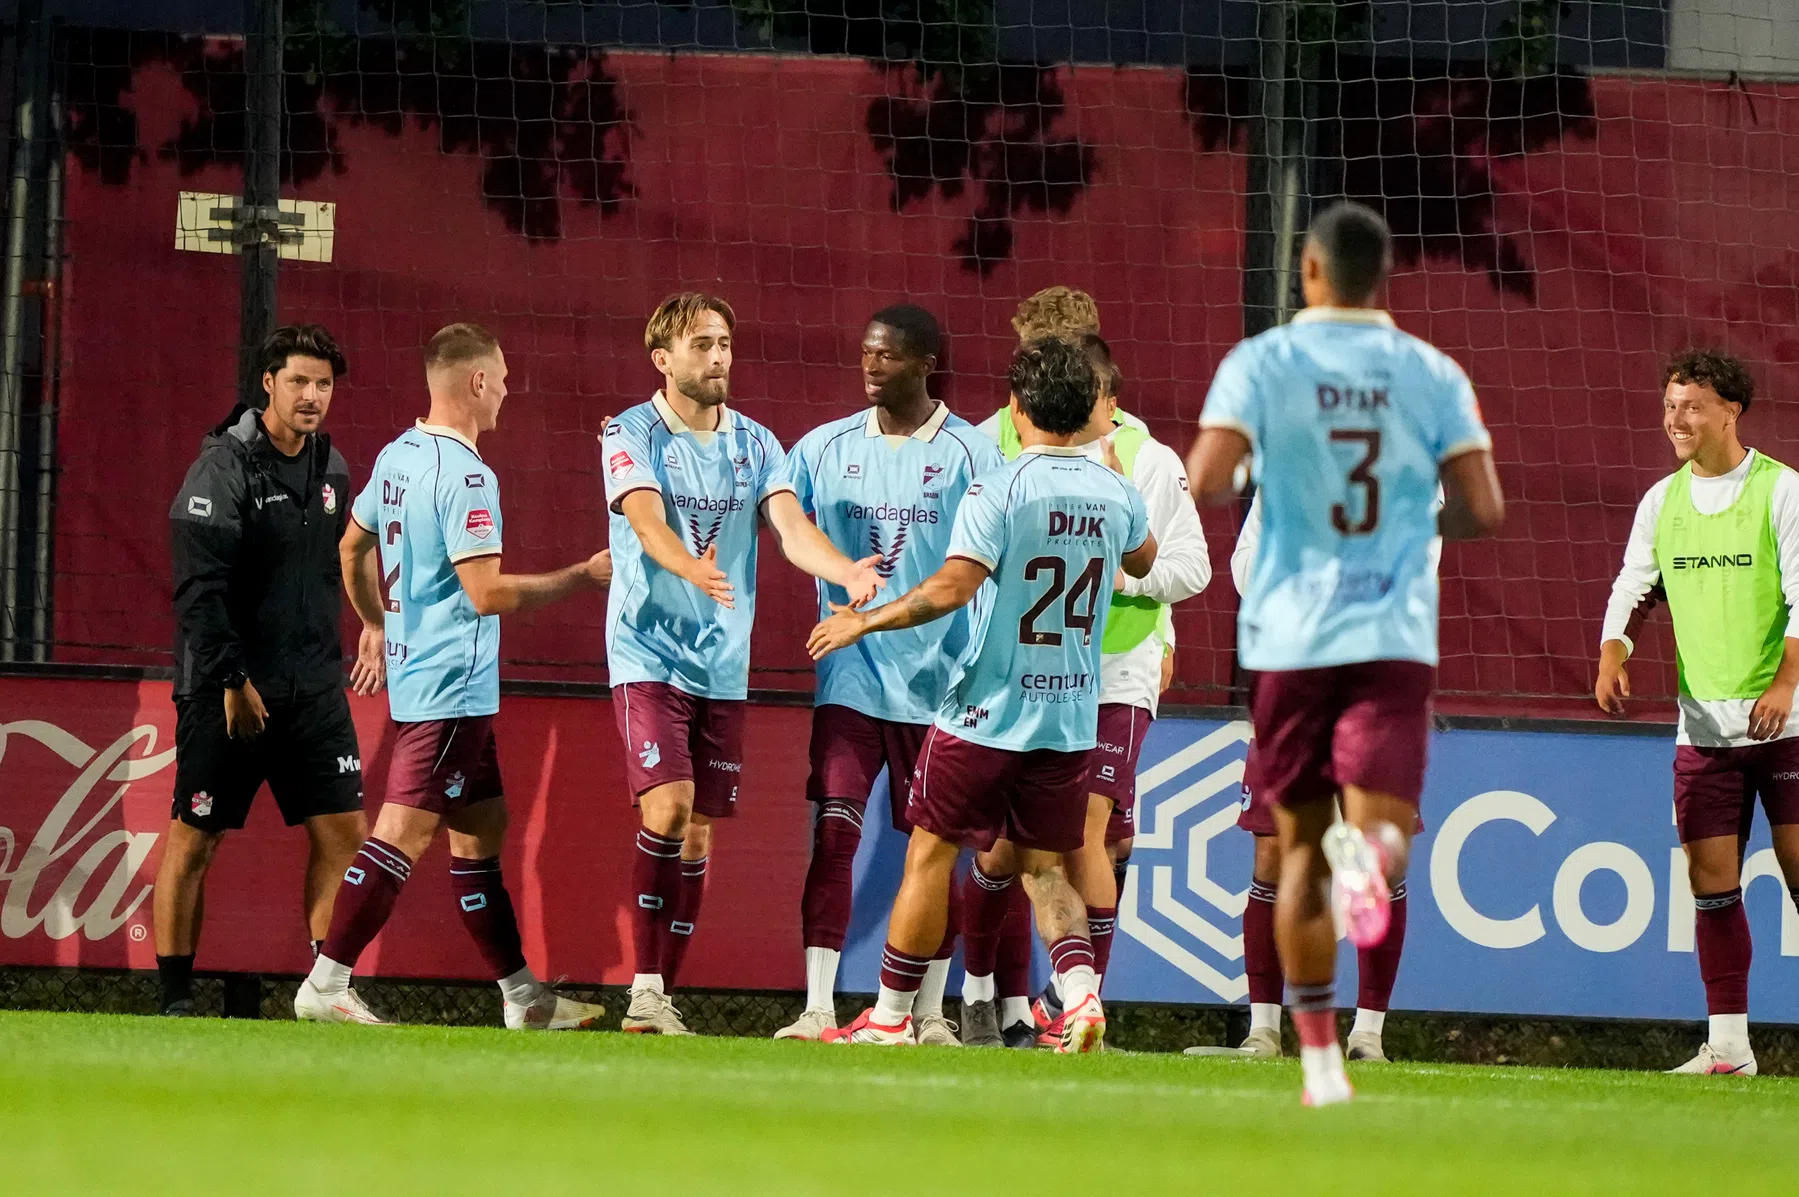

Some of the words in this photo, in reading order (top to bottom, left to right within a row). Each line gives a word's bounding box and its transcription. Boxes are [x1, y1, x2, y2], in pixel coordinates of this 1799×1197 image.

[1330, 429, 1381, 536] 3
[669, 492, 745, 515] vandaglas
[844, 502, 939, 526] vandaglas
[1085, 502, 1106, 512] VAN
[1048, 511, 1106, 539] DIJK
[1673, 553, 1753, 570] STANNO
[1017, 555, 1106, 647] 24
[1020, 672, 1095, 694] century
[963, 716, 978, 729] EN
